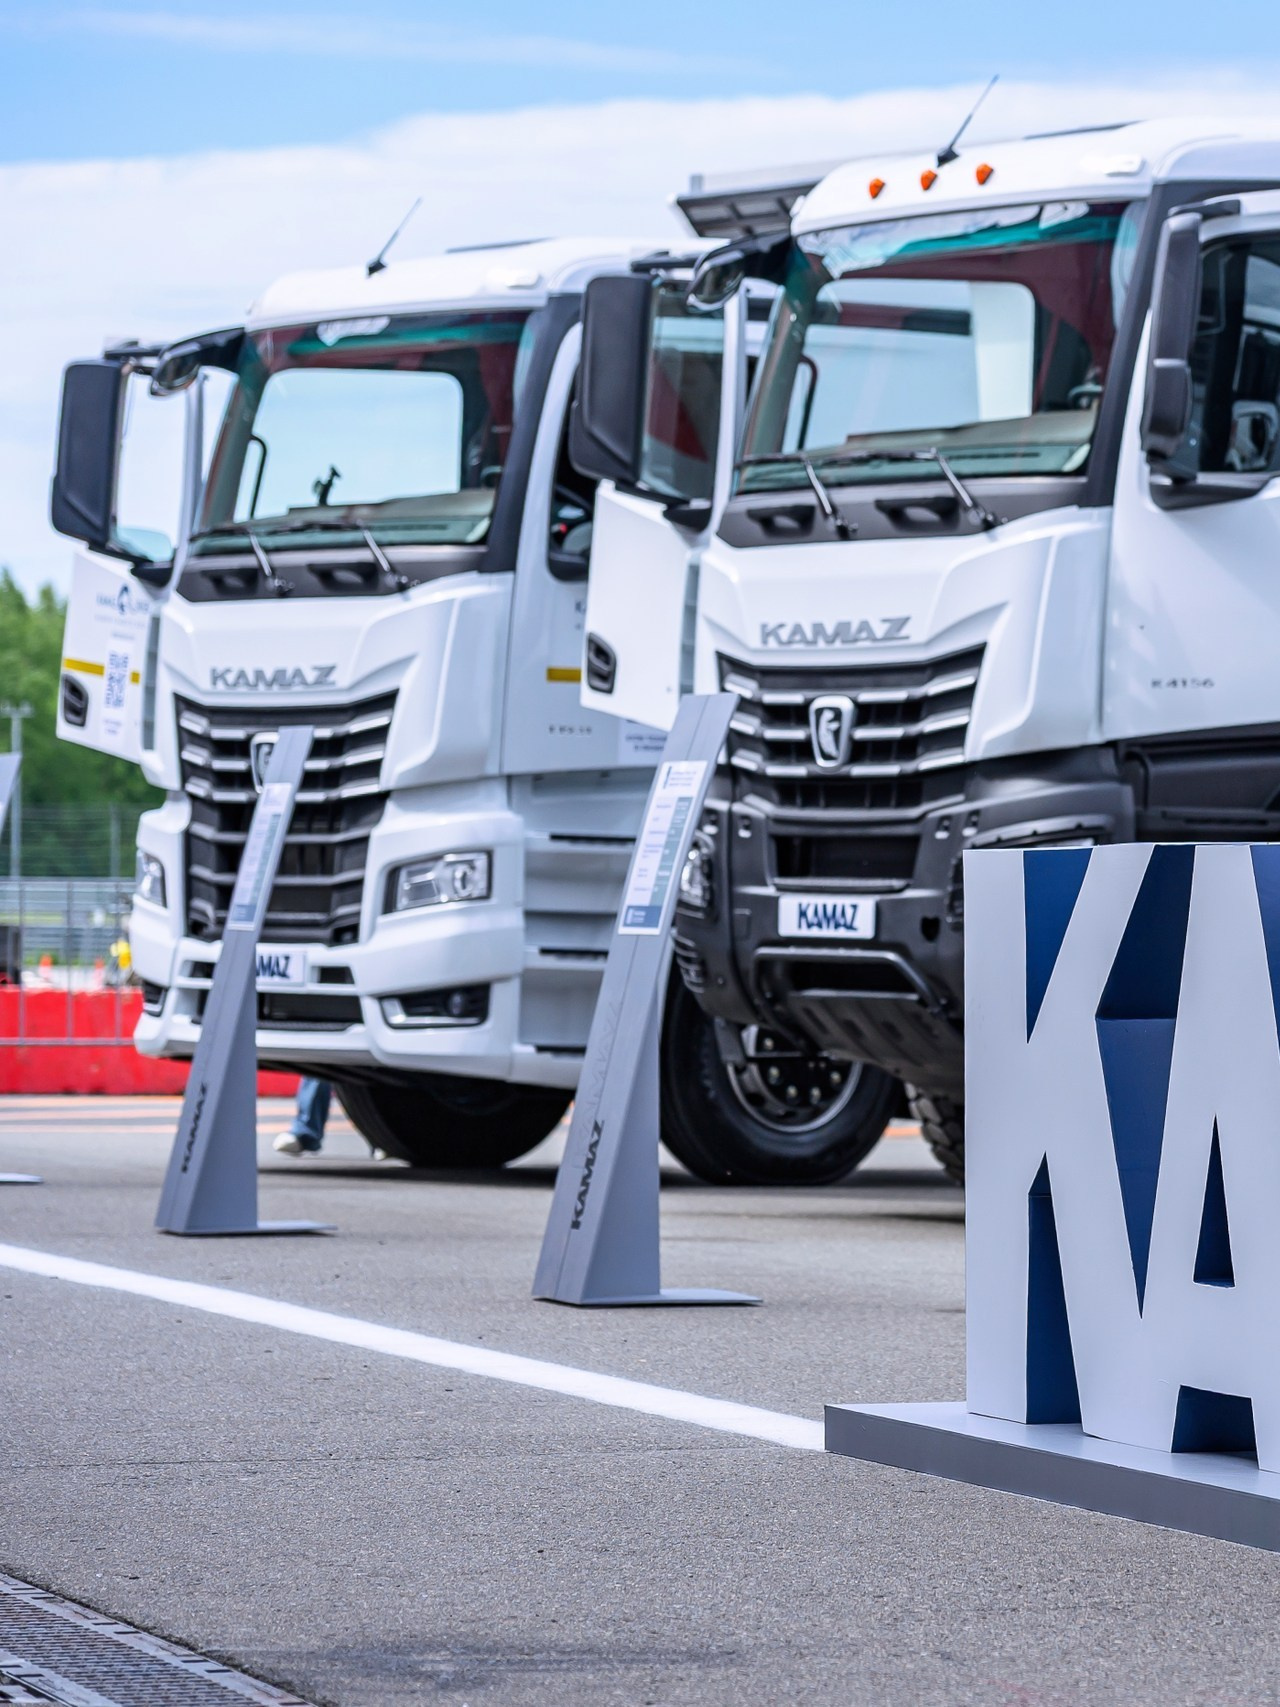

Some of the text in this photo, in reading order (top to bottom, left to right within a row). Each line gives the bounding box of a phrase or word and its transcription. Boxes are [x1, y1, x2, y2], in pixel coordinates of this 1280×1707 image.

[760, 616, 911, 645] KAMAZ
[210, 664, 337, 689] KAMAZ
[798, 903, 858, 931] KAMAZ
[571, 1119, 604, 1230] KAMAZ
